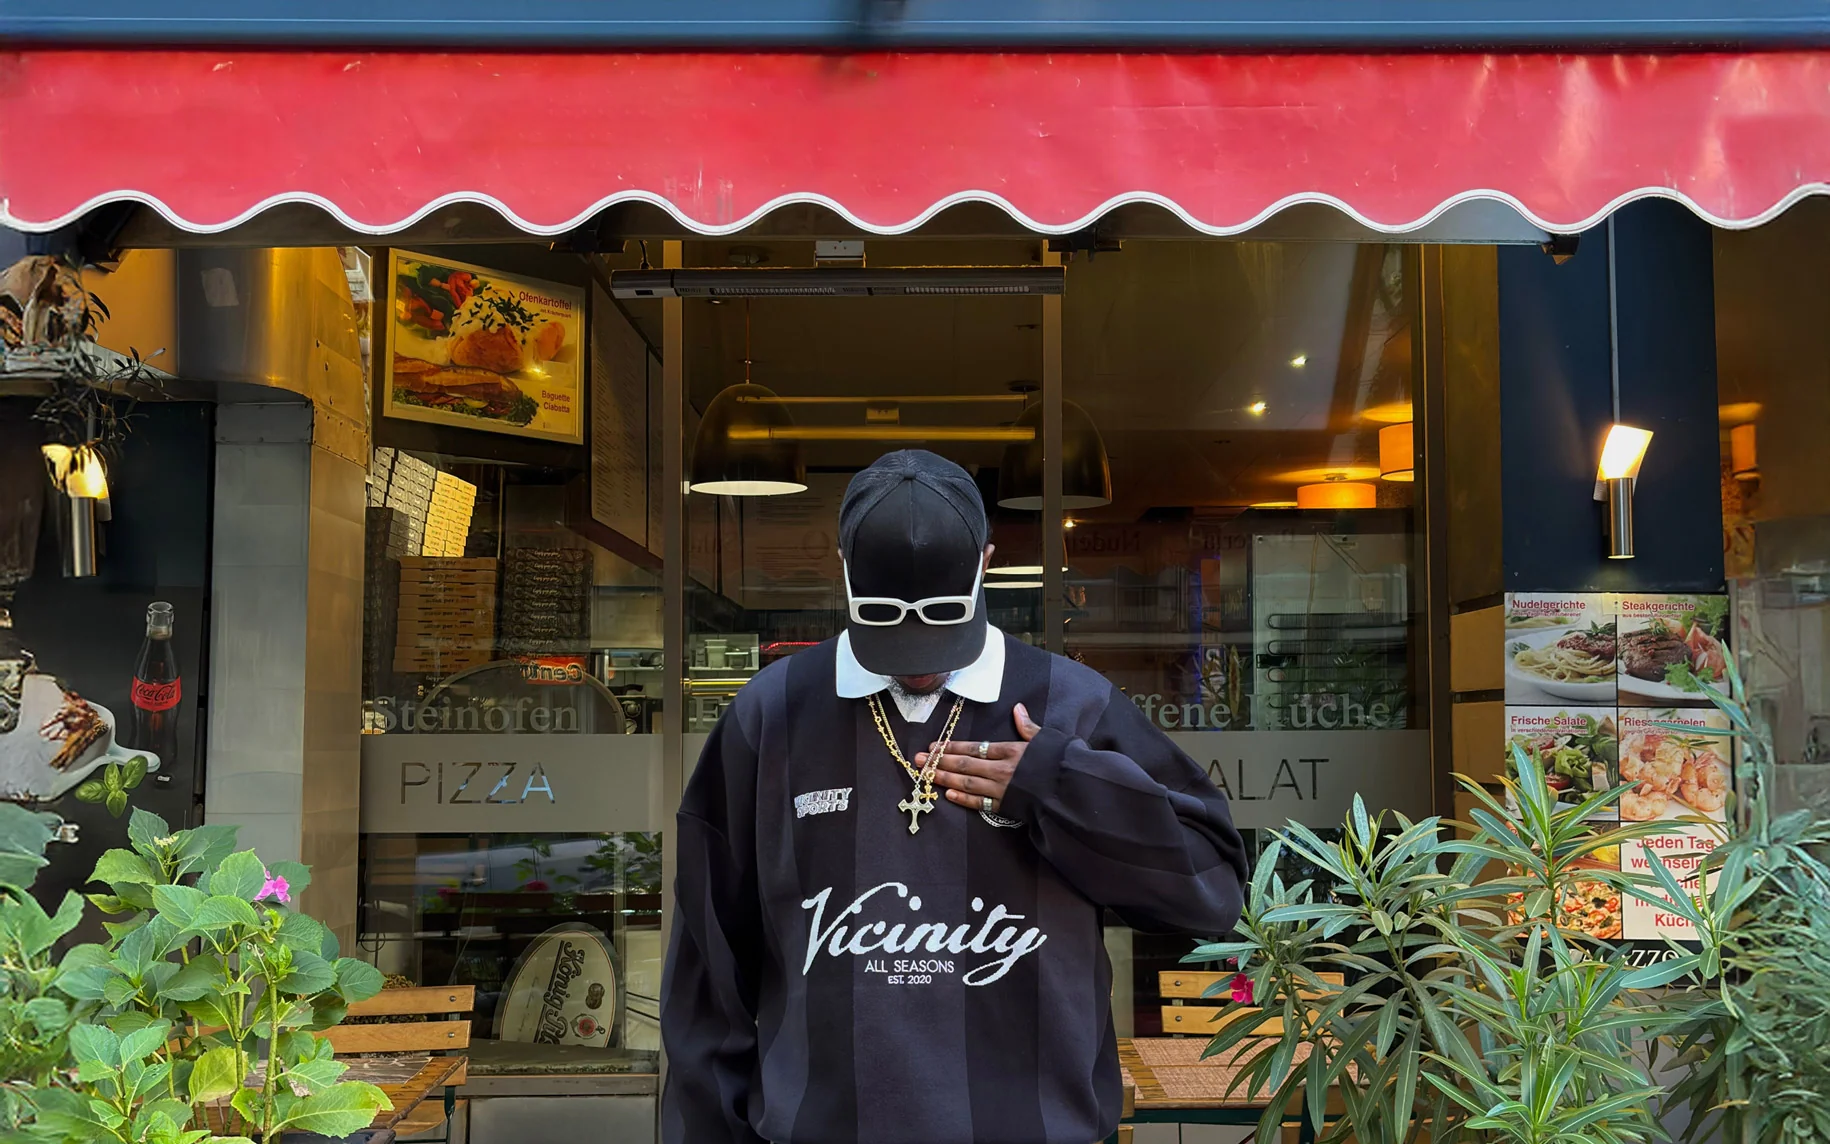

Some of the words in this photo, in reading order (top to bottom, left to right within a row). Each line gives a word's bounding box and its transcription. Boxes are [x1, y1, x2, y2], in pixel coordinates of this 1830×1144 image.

[519, 291, 572, 310] Ofenkartoffel
[541, 390, 571, 403] Baguette
[1512, 599, 1586, 612] Nudelgerichte
[1622, 601, 1695, 613] Steakgerichte
[373, 695, 580, 732] Steinofen
[1131, 692, 1231, 728] ffene
[1511, 716, 1552, 726] Frische
[1554, 716, 1587, 726] Salate
[400, 762, 556, 804] PIZZA
[1208, 758, 1330, 800] ALAT
[796, 799, 849, 819] SPORTS
[1636, 836, 1684, 849] Jeden
[1686, 836, 1715, 852] Tag
[1655, 914, 1695, 927] Küch
[801, 882, 1047, 986] Vicinity
[864, 959, 889, 973] ALL
[893, 959, 955, 973] SEASONS
[888, 975, 905, 985] EST.
[907, 975, 932, 985] 2020
